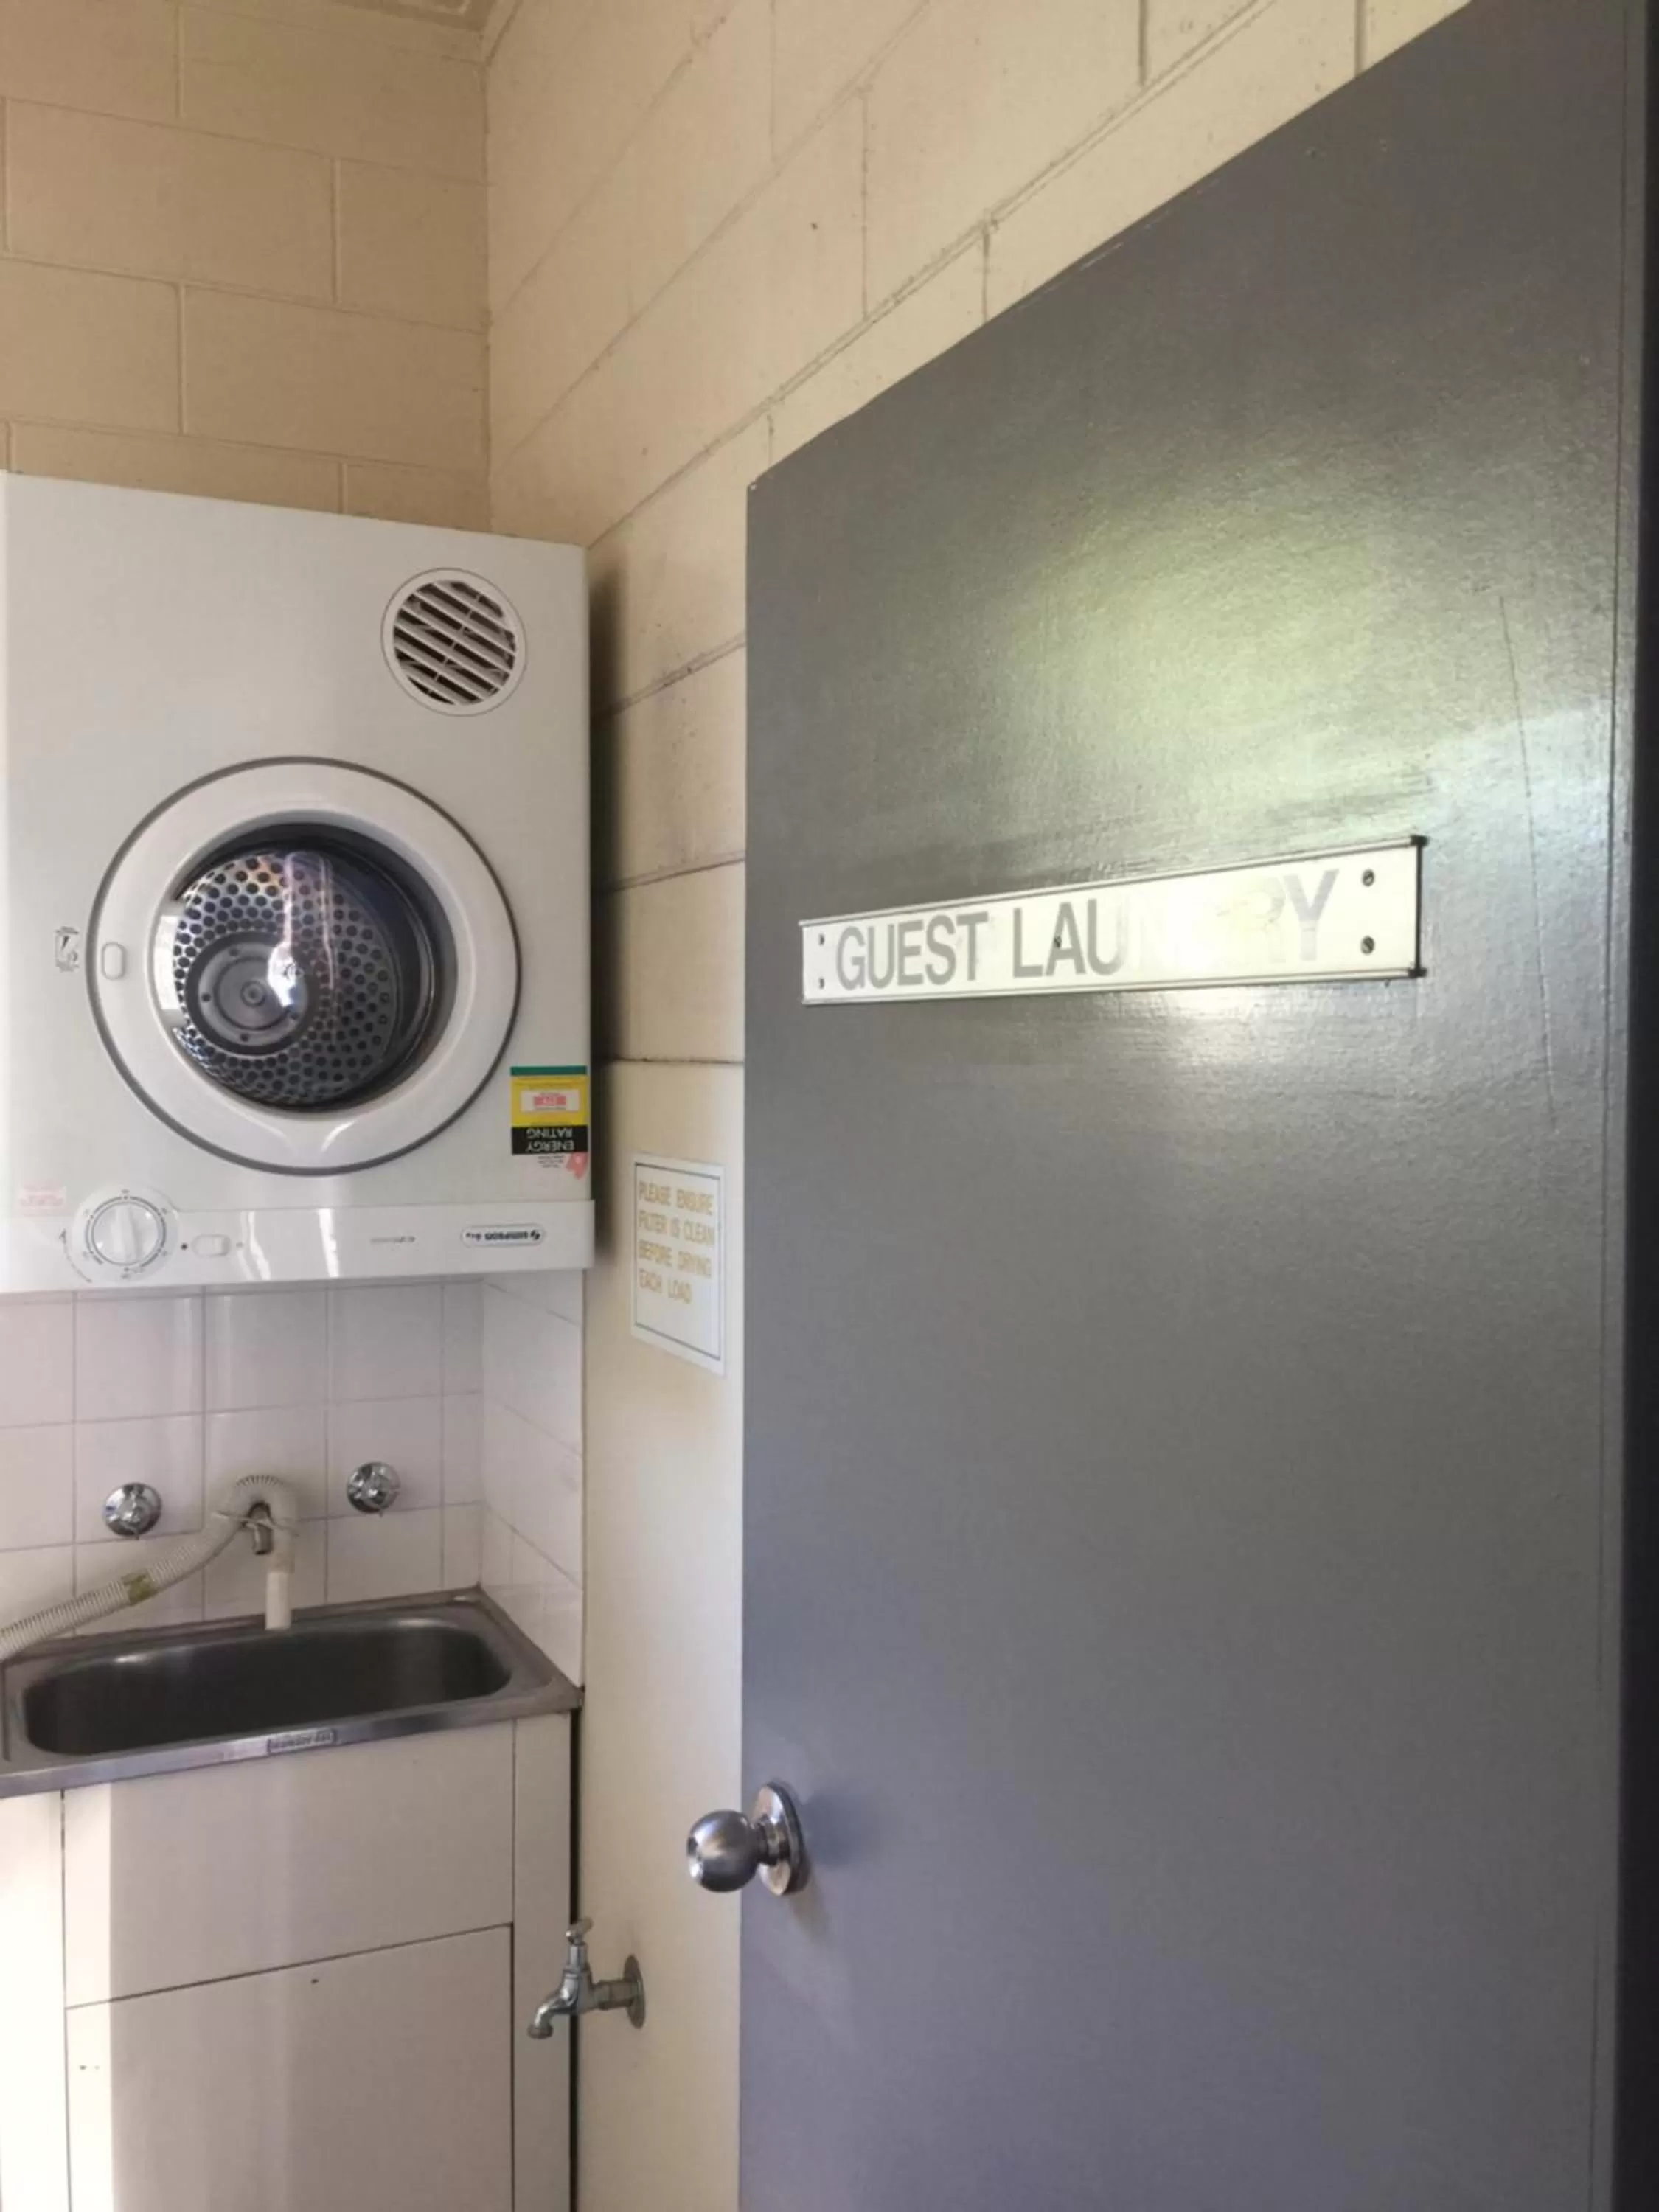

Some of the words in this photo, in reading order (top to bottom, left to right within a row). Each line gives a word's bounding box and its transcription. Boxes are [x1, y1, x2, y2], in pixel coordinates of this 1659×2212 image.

[836, 911, 989, 991] GUEST
[1012, 868, 1340, 978] LAURY
[525, 1140, 575, 1152] ENERGY
[526, 1127, 573, 1139] RATING
[639, 1181, 671, 1207] PLEASE
[684, 1220, 715, 1246] CLEAN
[668, 1278, 692, 1304] LOAD
